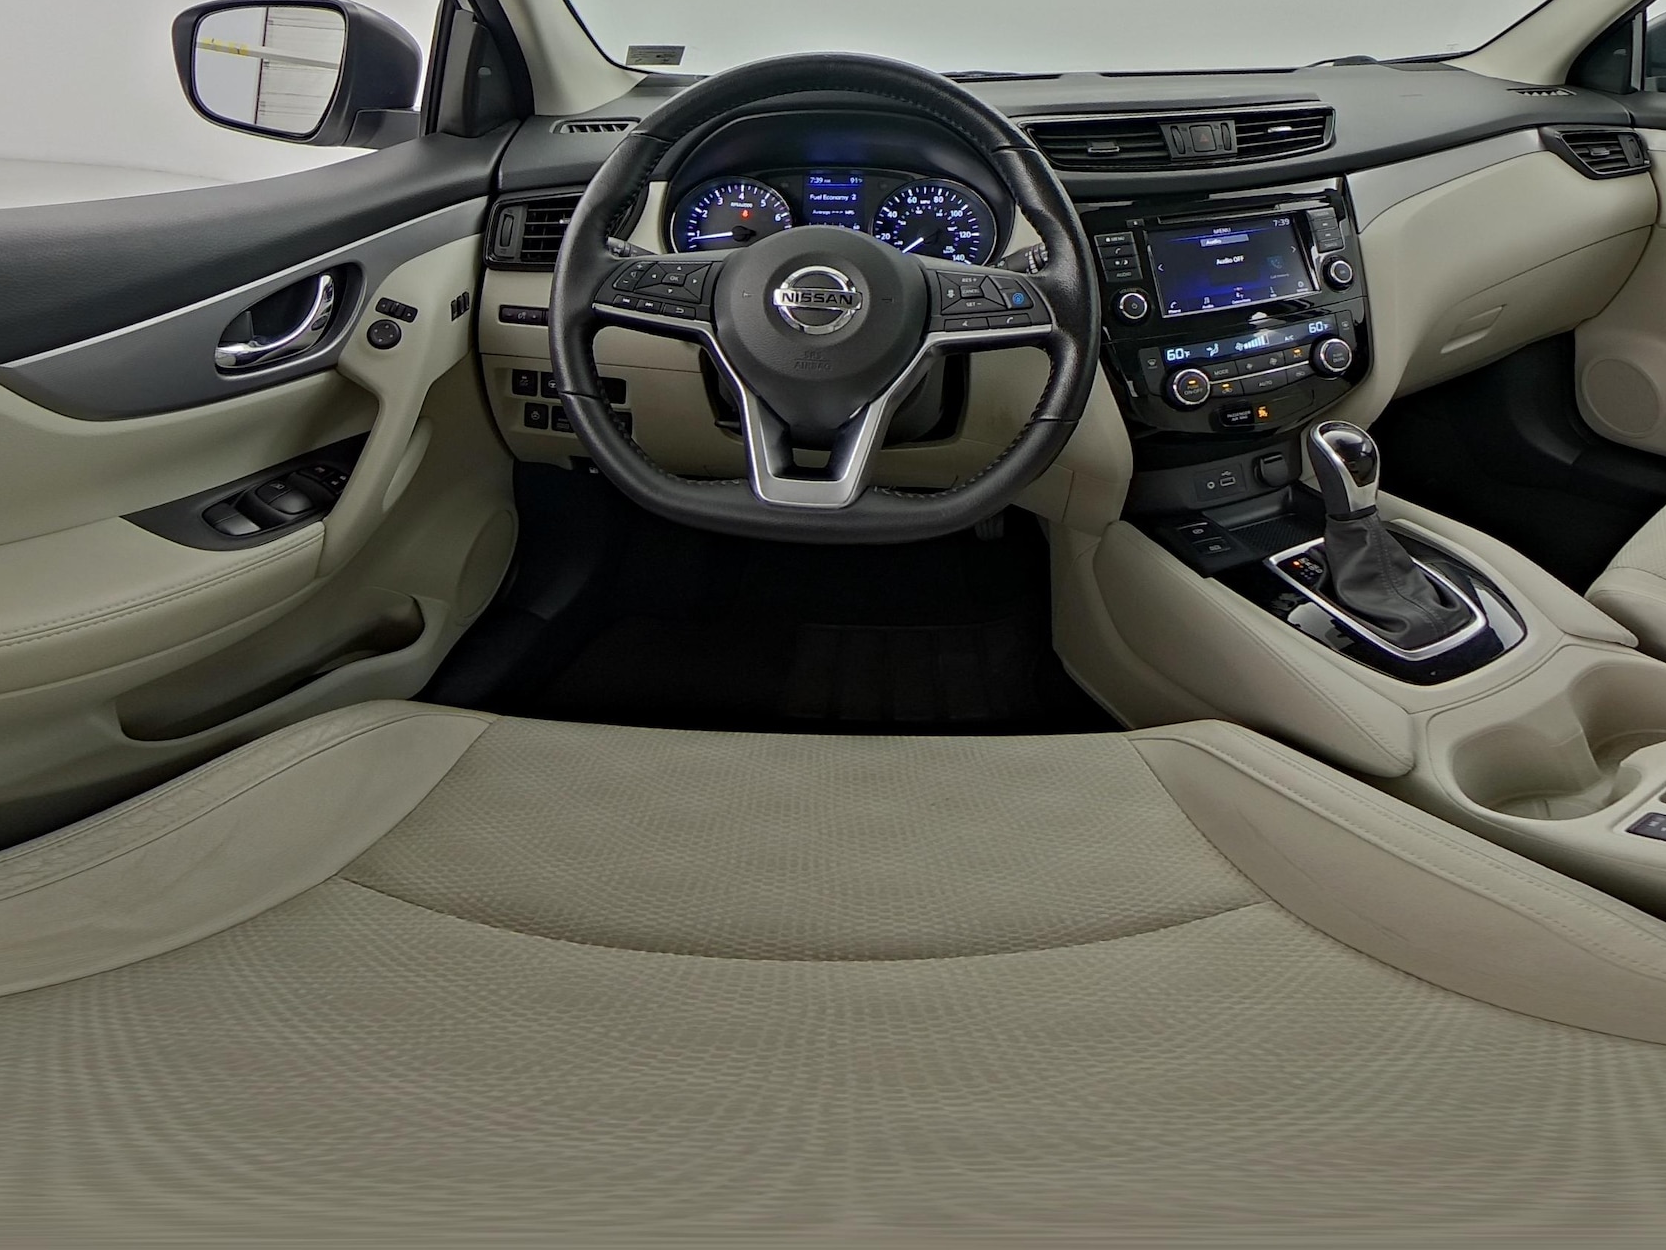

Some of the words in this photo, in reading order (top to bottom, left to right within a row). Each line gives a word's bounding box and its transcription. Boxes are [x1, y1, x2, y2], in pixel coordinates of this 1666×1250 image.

[718, 197, 723, 205] 3
[760, 199, 766, 207] 5
[702, 210, 708, 218] 2
[775, 213, 781, 221] 6
[1273, 218, 1290, 226] 7:39
[1213, 227, 1231, 235] MENU
[1216, 256, 1233, 265] Audio
[1233, 255, 1245, 263] OFF
[782, 292, 853, 305] NISSAN
